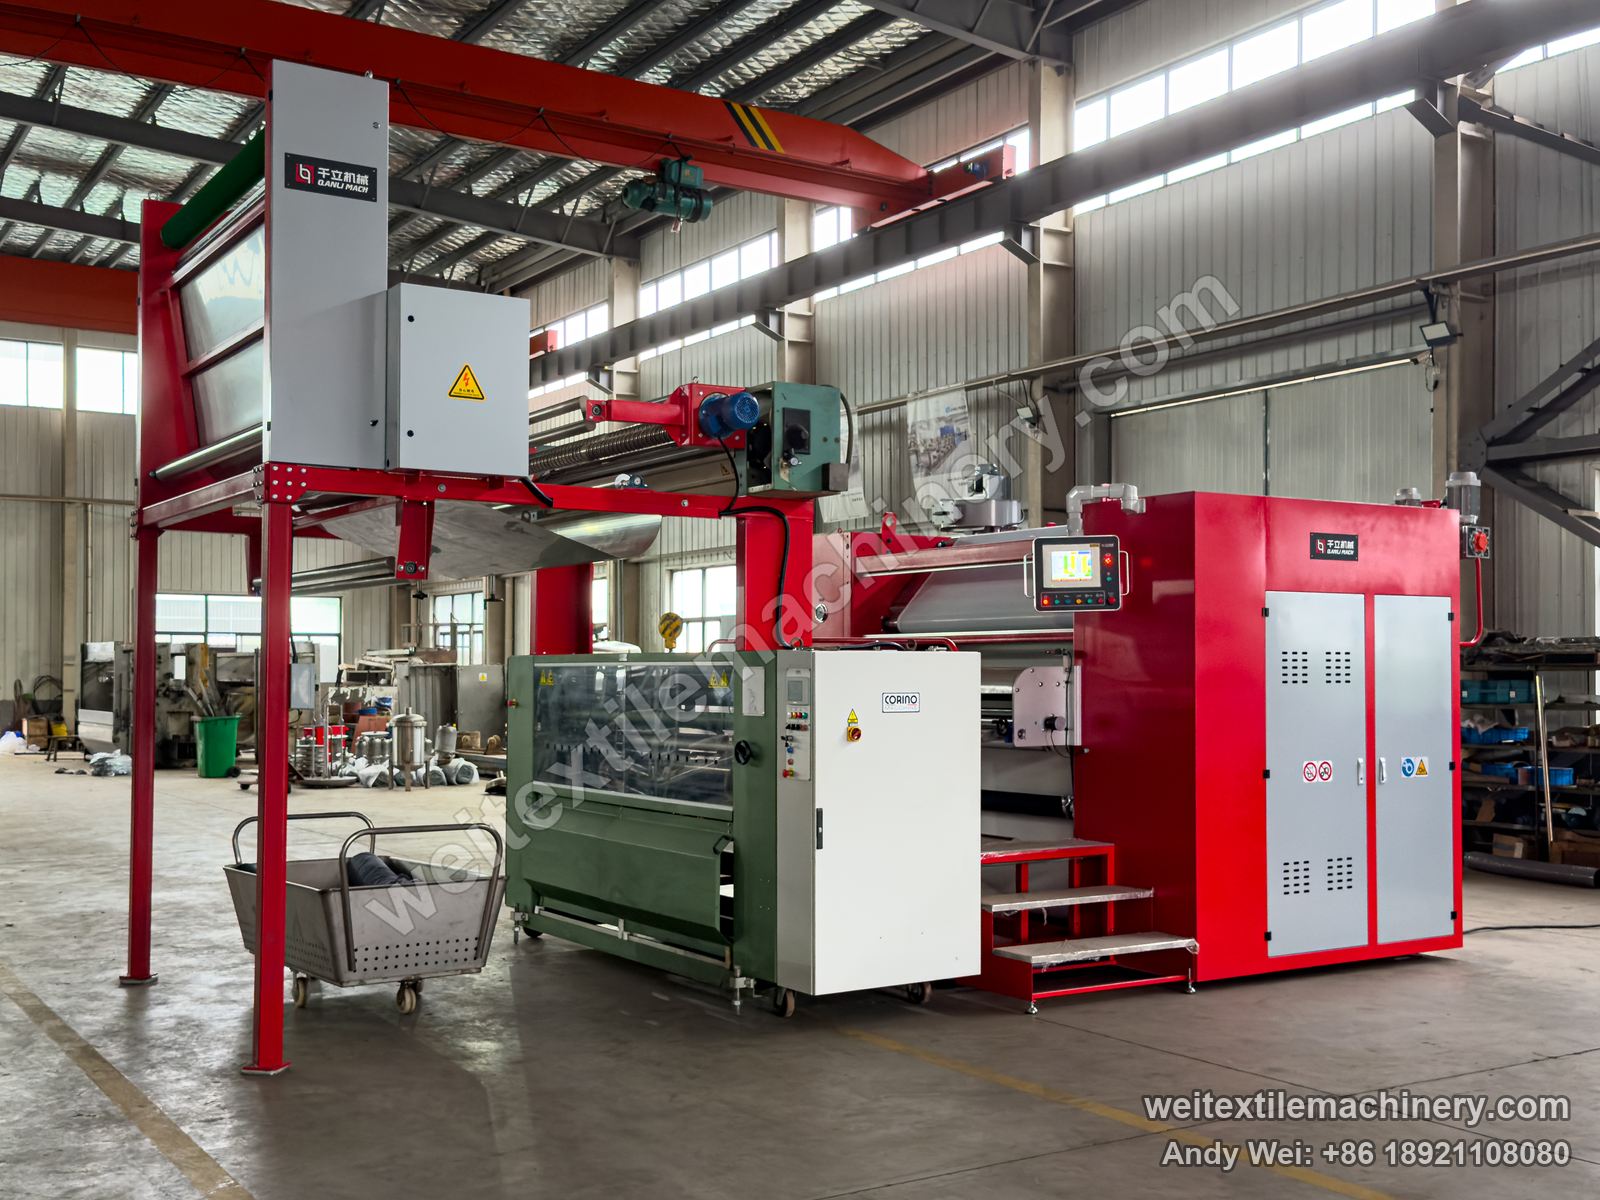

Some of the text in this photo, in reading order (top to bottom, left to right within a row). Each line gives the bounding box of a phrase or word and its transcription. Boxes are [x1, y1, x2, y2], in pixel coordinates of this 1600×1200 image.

[317, 167, 369, 186] 千立机械
[345, 183, 369, 193] MACH
[884, 695, 918, 705] CORINO
